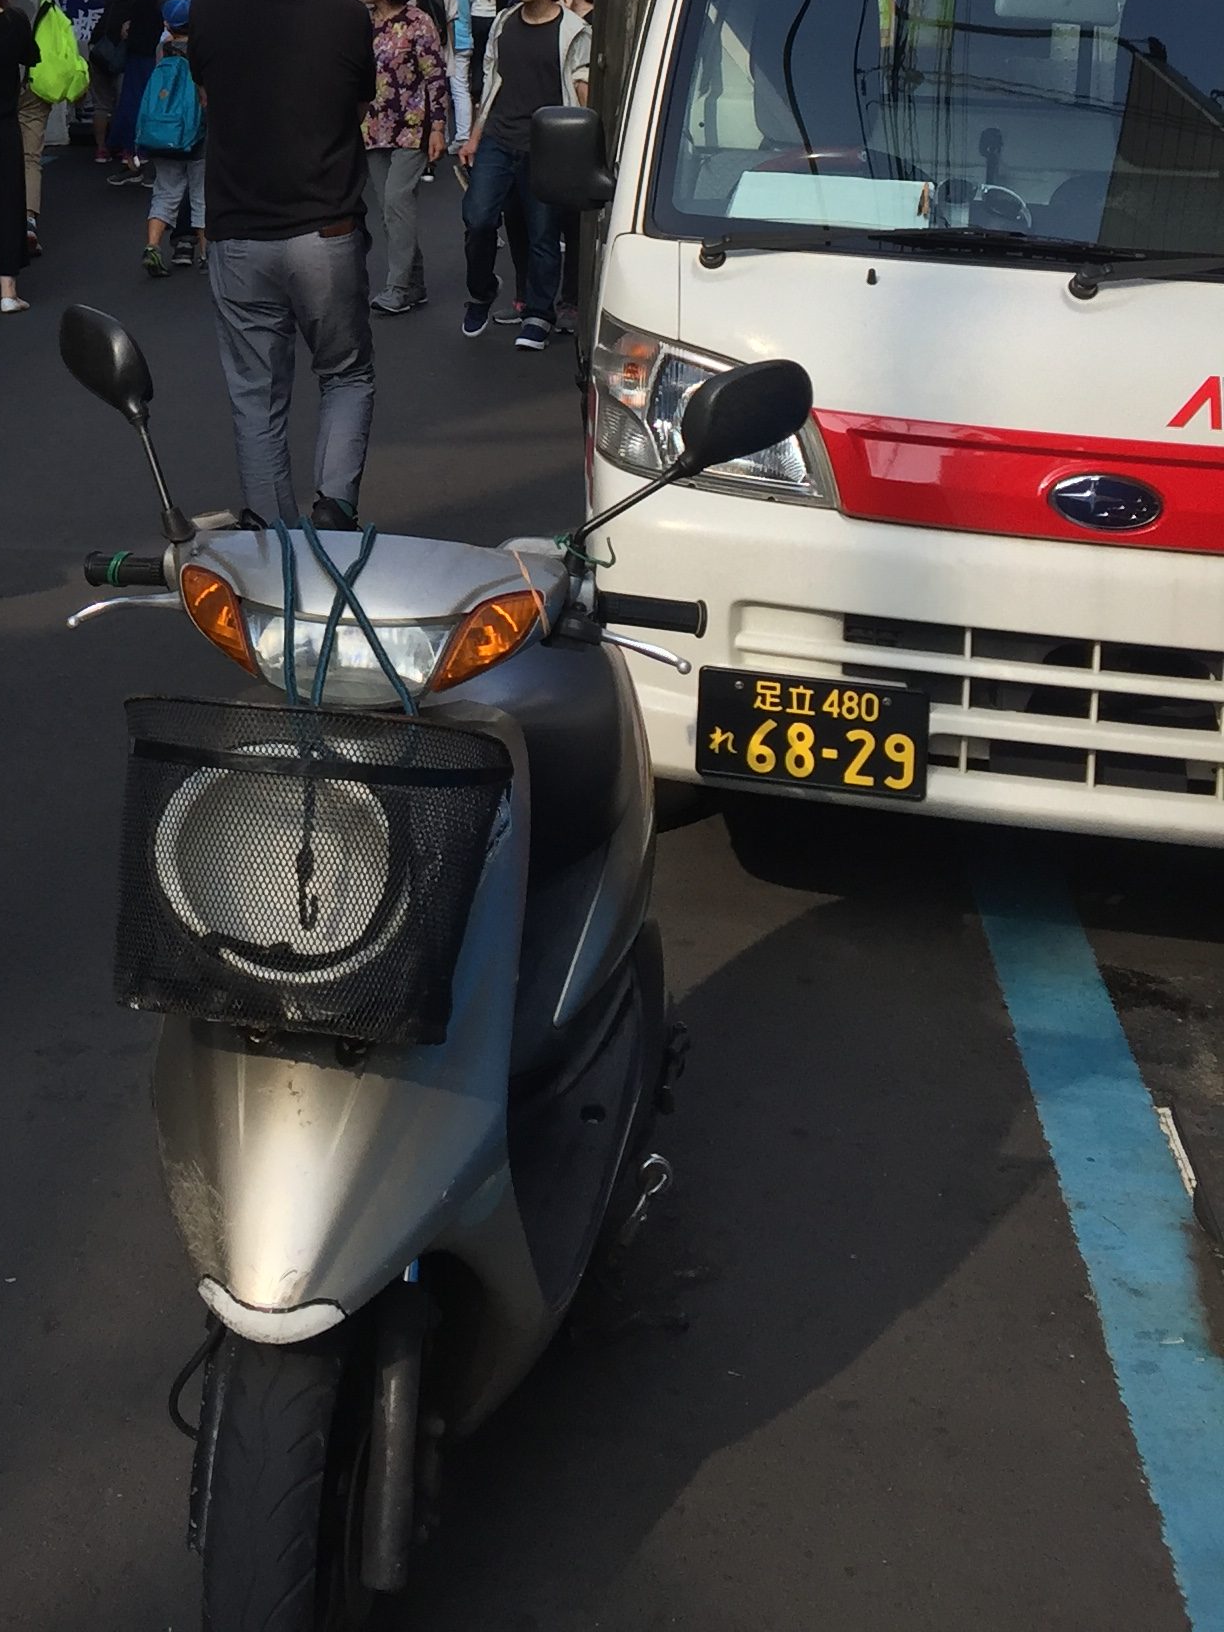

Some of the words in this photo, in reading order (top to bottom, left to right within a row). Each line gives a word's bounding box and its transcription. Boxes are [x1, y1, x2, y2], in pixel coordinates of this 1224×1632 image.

[753, 680, 816, 717] 足立
[822, 688, 879, 722] 480
[709, 726, 738, 755] れ
[746, 718, 916, 791] 68-29
